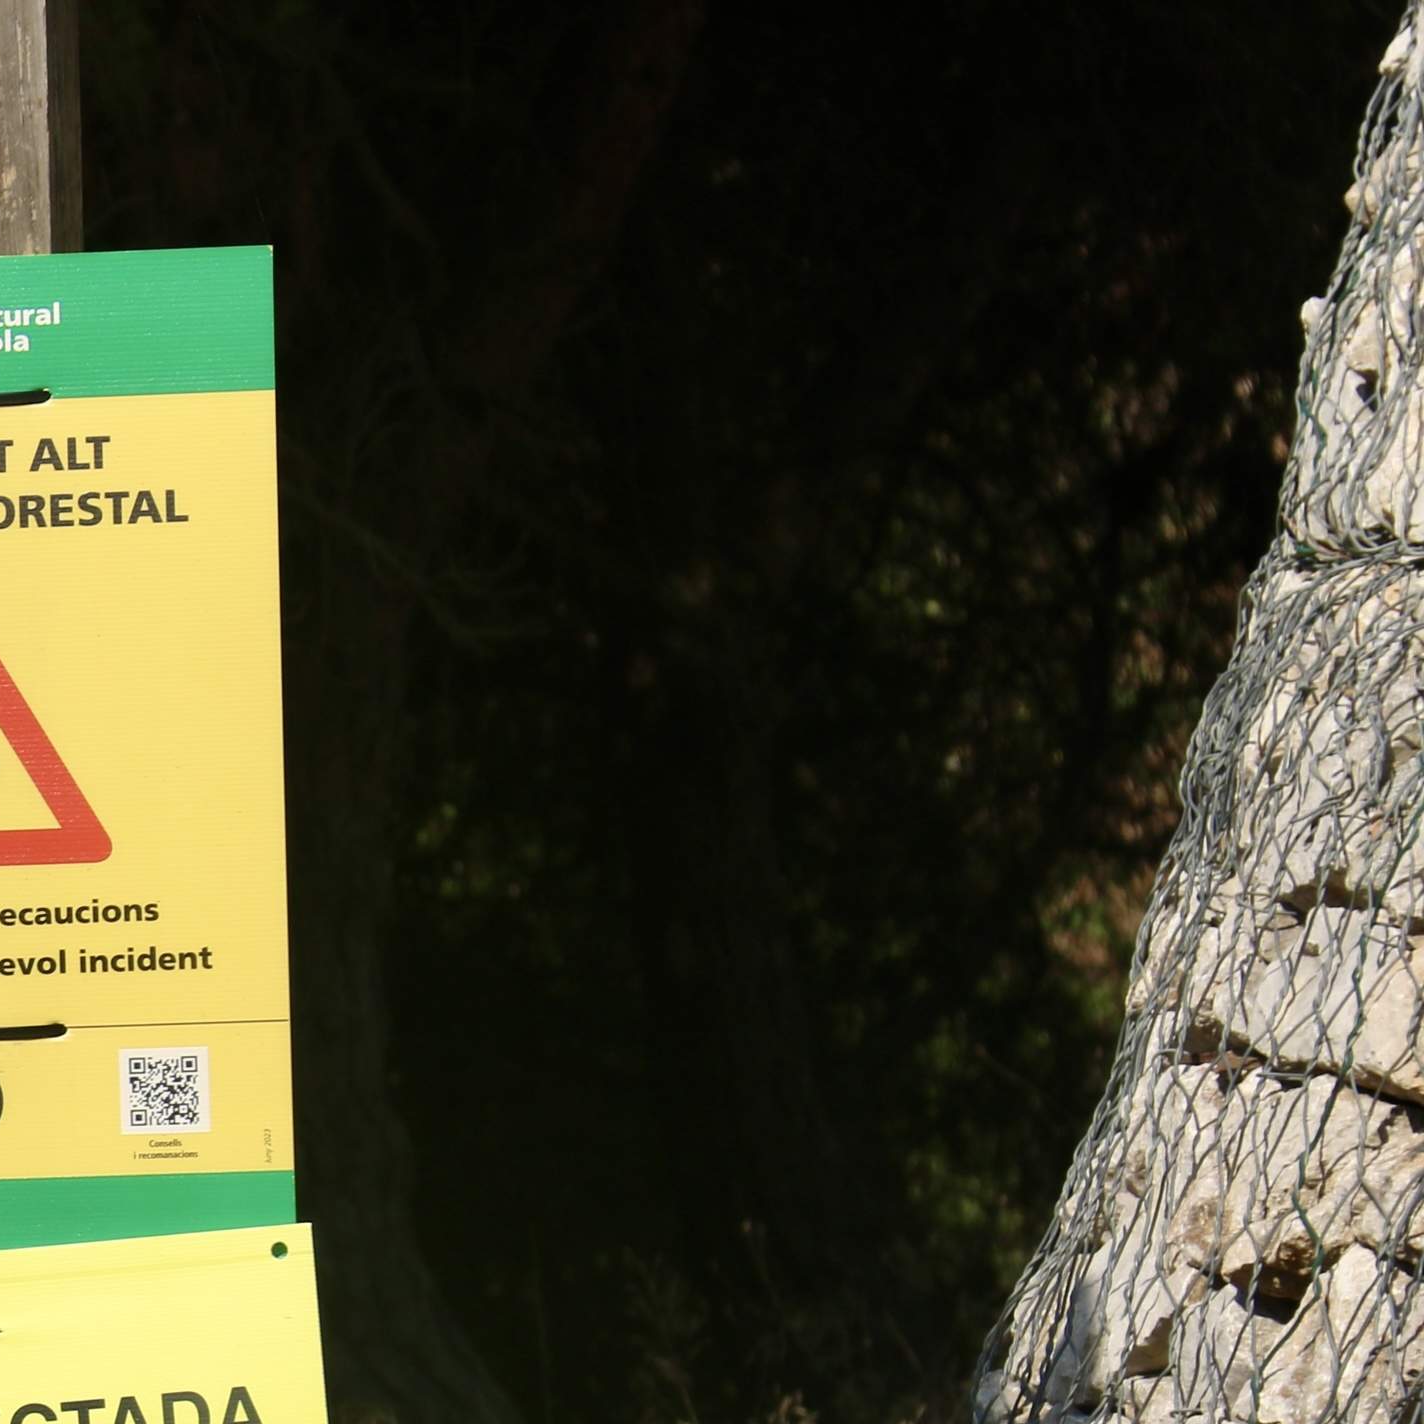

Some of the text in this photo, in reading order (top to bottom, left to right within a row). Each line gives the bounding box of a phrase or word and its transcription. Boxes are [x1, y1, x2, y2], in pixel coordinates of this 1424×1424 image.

[30, 436, 110, 472] ALT
[80, 946, 212, 973] incident
[149, 1139, 182, 1147] Consells
